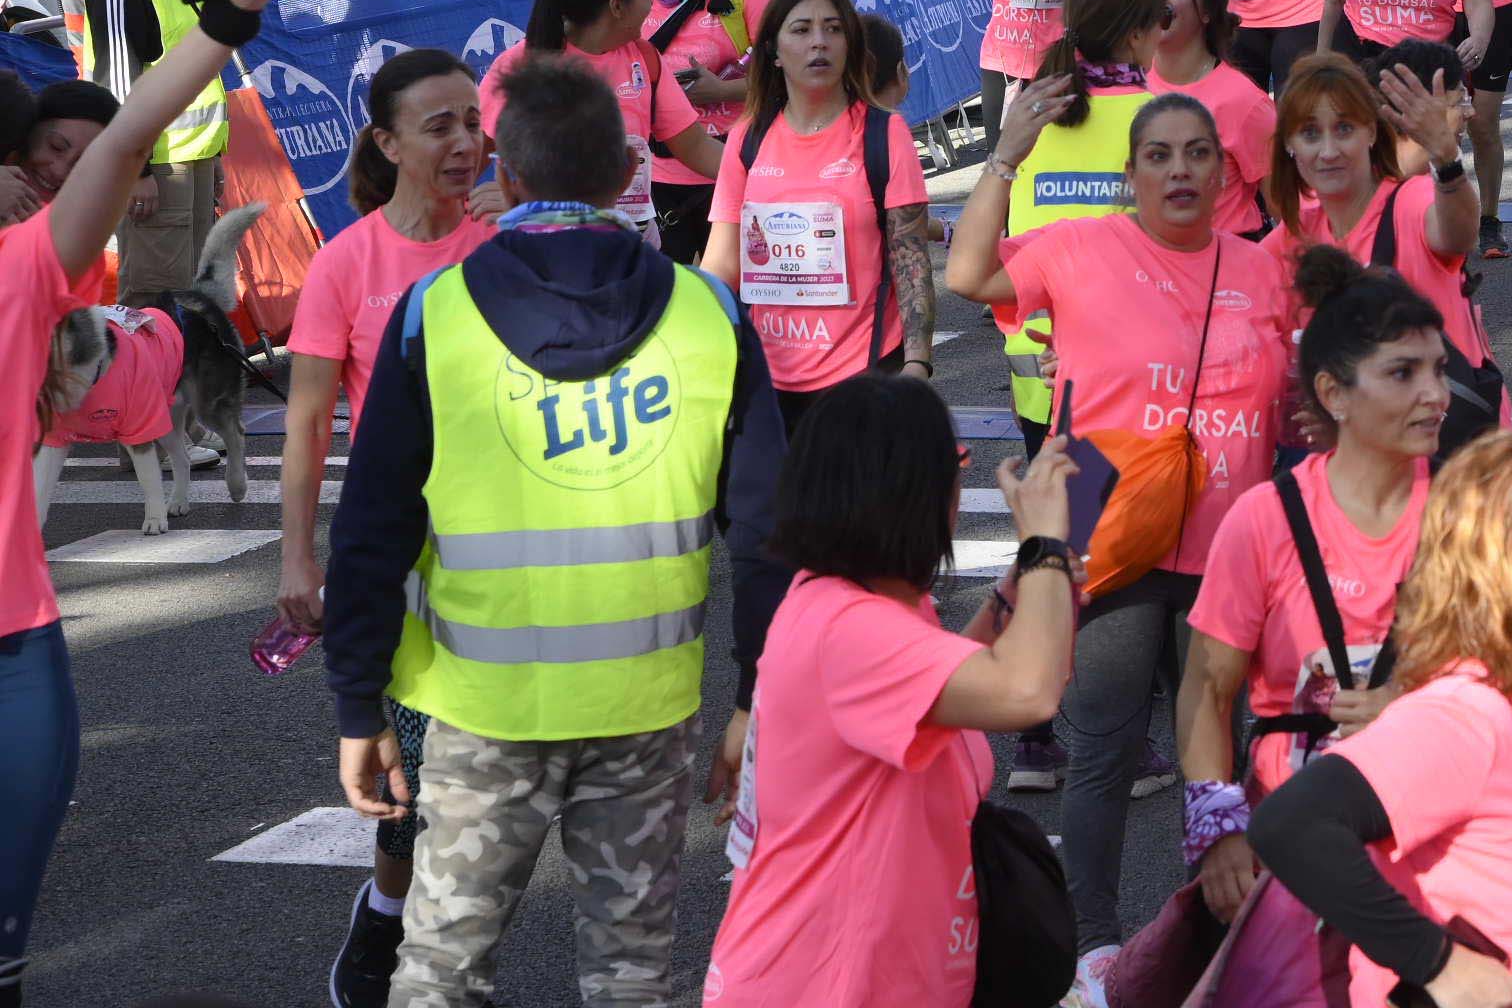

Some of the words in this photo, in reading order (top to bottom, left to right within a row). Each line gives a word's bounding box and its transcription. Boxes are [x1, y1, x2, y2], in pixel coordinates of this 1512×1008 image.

[992, 3, 1049, 23] DORSAL
[1359, 5, 1434, 26] SUMA
[275, 117, 348, 161] TURIANA
[1034, 178, 1135, 199] VOLUNTARI
[766, 220, 807, 231] ASTURIANA
[771, 243, 806, 259] 016
[779, 263, 800, 272] 4820
[753, 275, 780, 283] CARRERA
[797, 275, 818, 283] MUJER
[367, 294, 403, 308] OYS
[750, 288, 781, 298] OYSHO
[804, 289, 838, 298] Santander
[760, 311, 831, 341] SUMA
[1147, 362, 1185, 394] TU
[536, 366, 672, 461] Life
[1142, 403, 1261, 438] DORSAL
